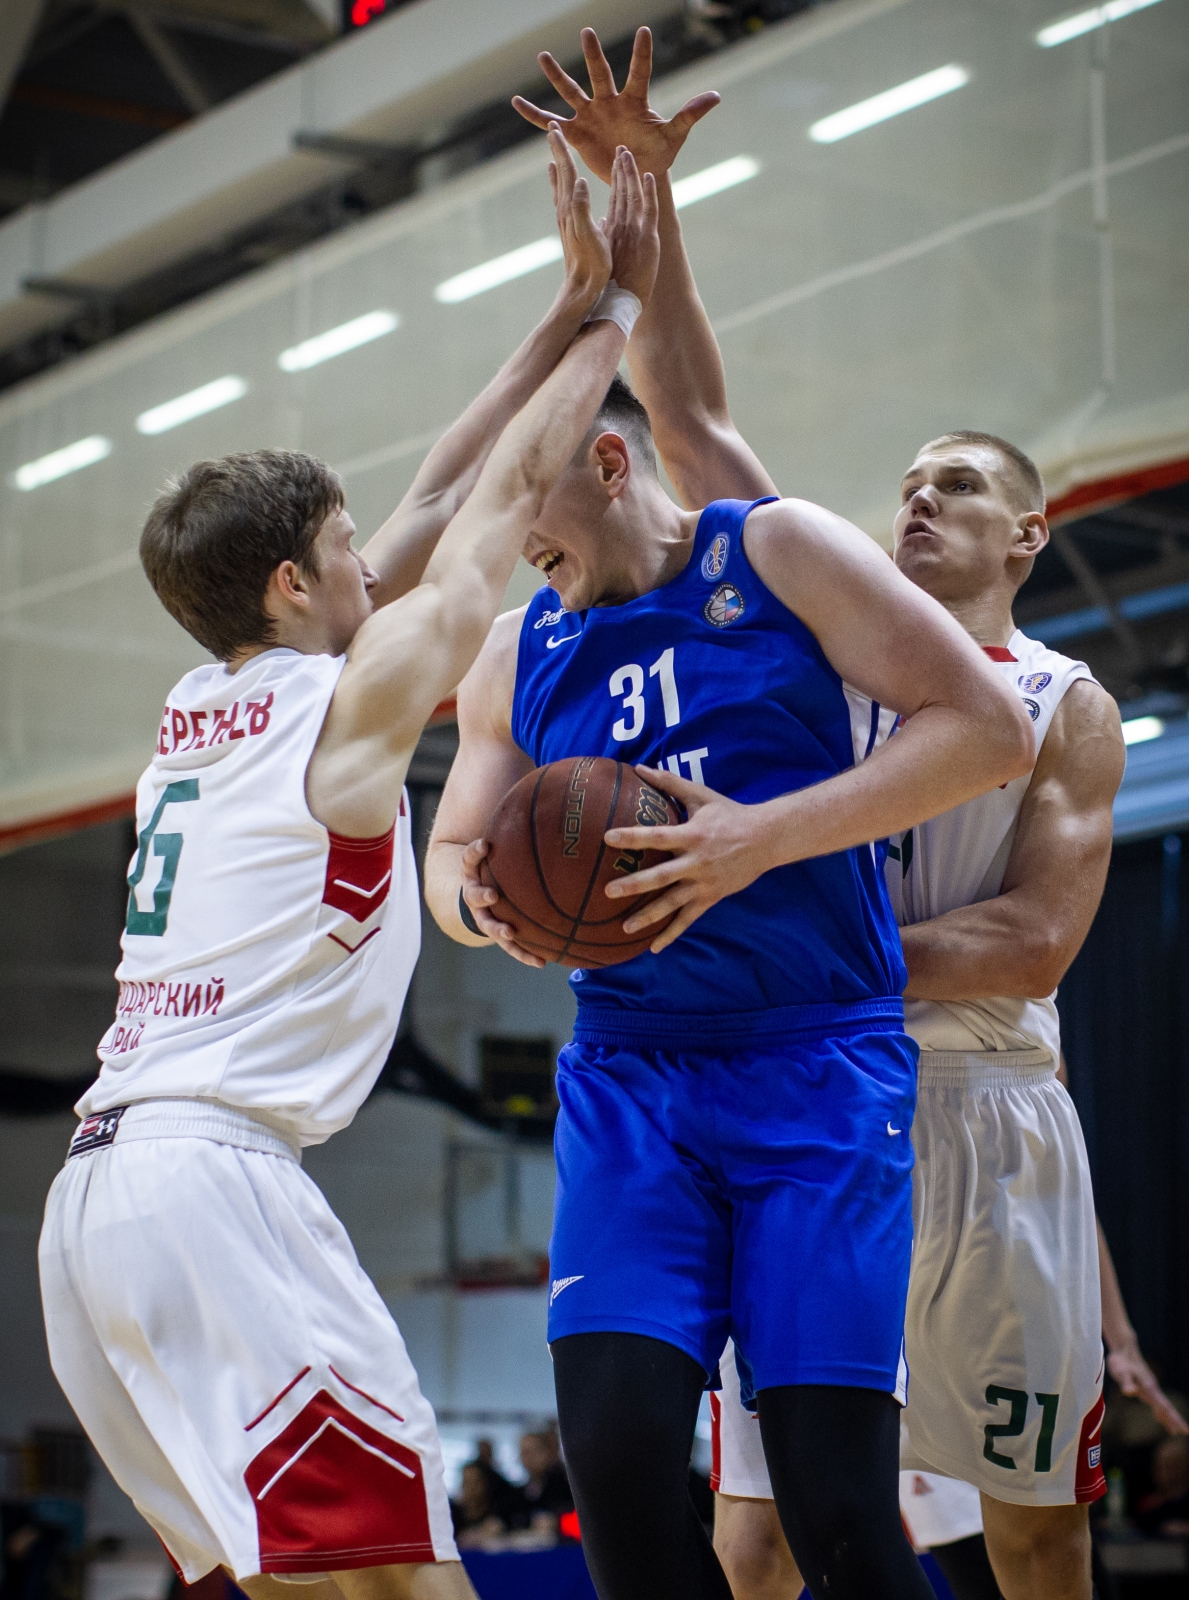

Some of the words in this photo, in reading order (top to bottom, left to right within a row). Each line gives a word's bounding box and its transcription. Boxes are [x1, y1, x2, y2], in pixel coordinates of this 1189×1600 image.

[609, 647, 681, 742] 31
[563, 756, 597, 859] OLUTION
[126, 778, 200, 937] 6
[119, 976, 225, 1018] ОДАРСКИЙ
[982, 1383, 1060, 1473] 21
